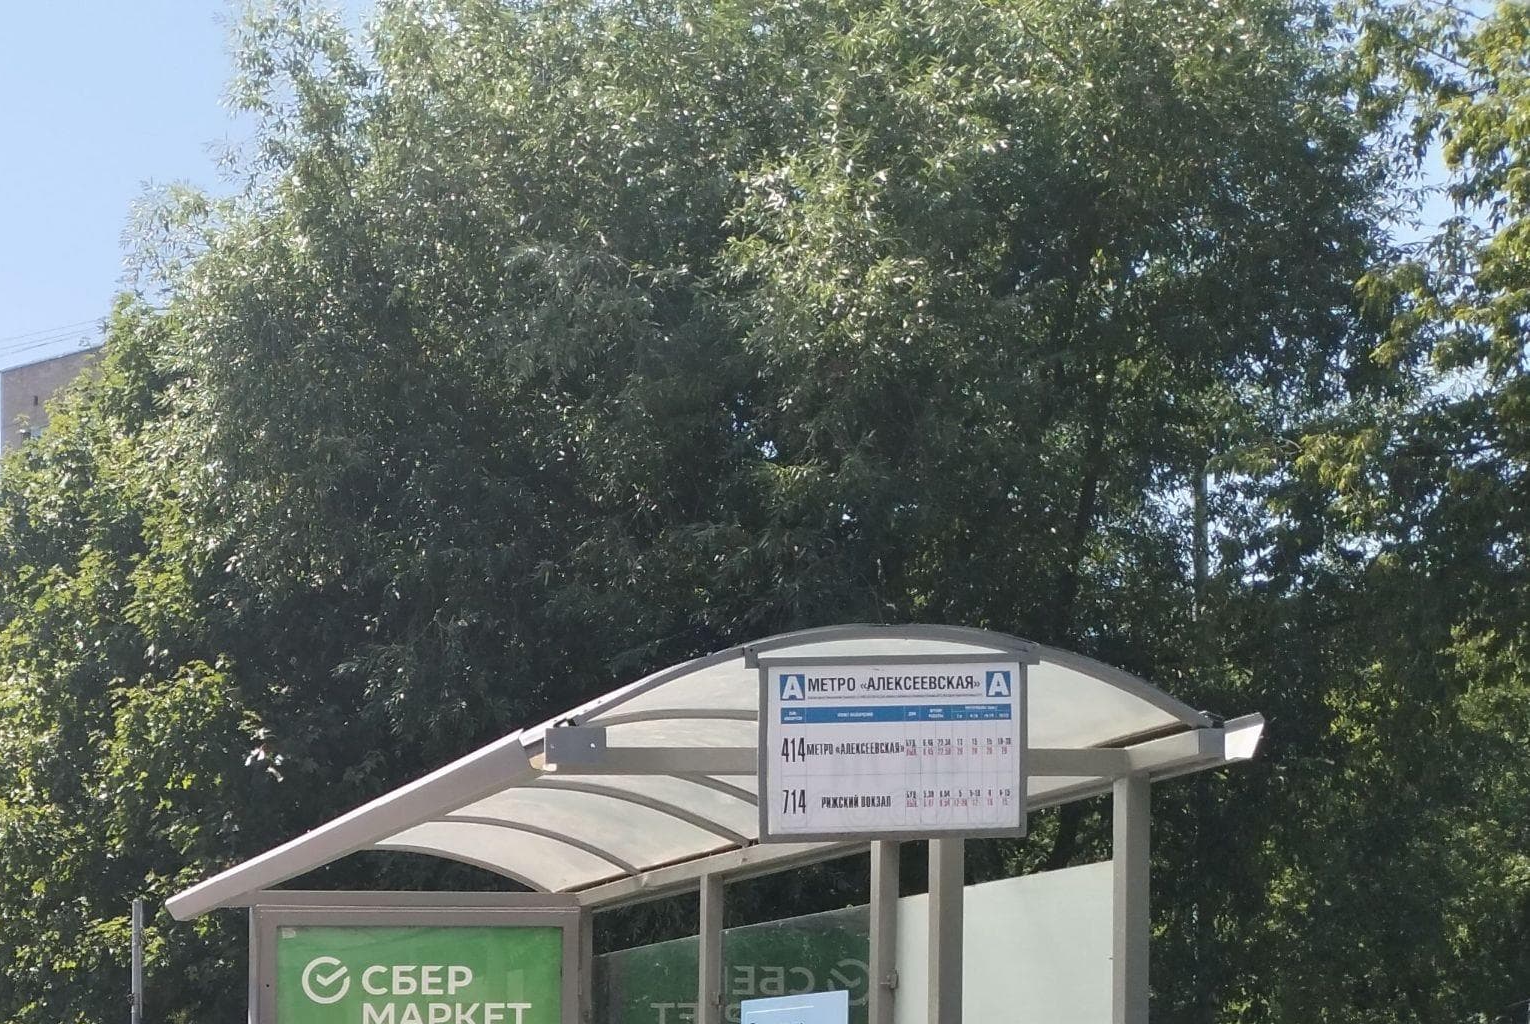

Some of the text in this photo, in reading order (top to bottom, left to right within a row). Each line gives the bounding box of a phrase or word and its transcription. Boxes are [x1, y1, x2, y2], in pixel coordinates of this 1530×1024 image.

[808, 677, 856, 692] МЕТРО
[860, 675, 981, 692] «АЛЕКСЕЕВСКАЯ»
[781, 737, 806, 763] 414
[806, 743, 834, 756] МЕТРО
[835, 741, 905, 755] «АЛЕКСЕЕВСКАЯ»
[782, 789, 807, 814] 714
[821, 794, 859, 809] РИЖСКИЙ
[861, 795, 892, 808] ВОКЗАЛ
[361, 965, 473, 995] СБЕР
